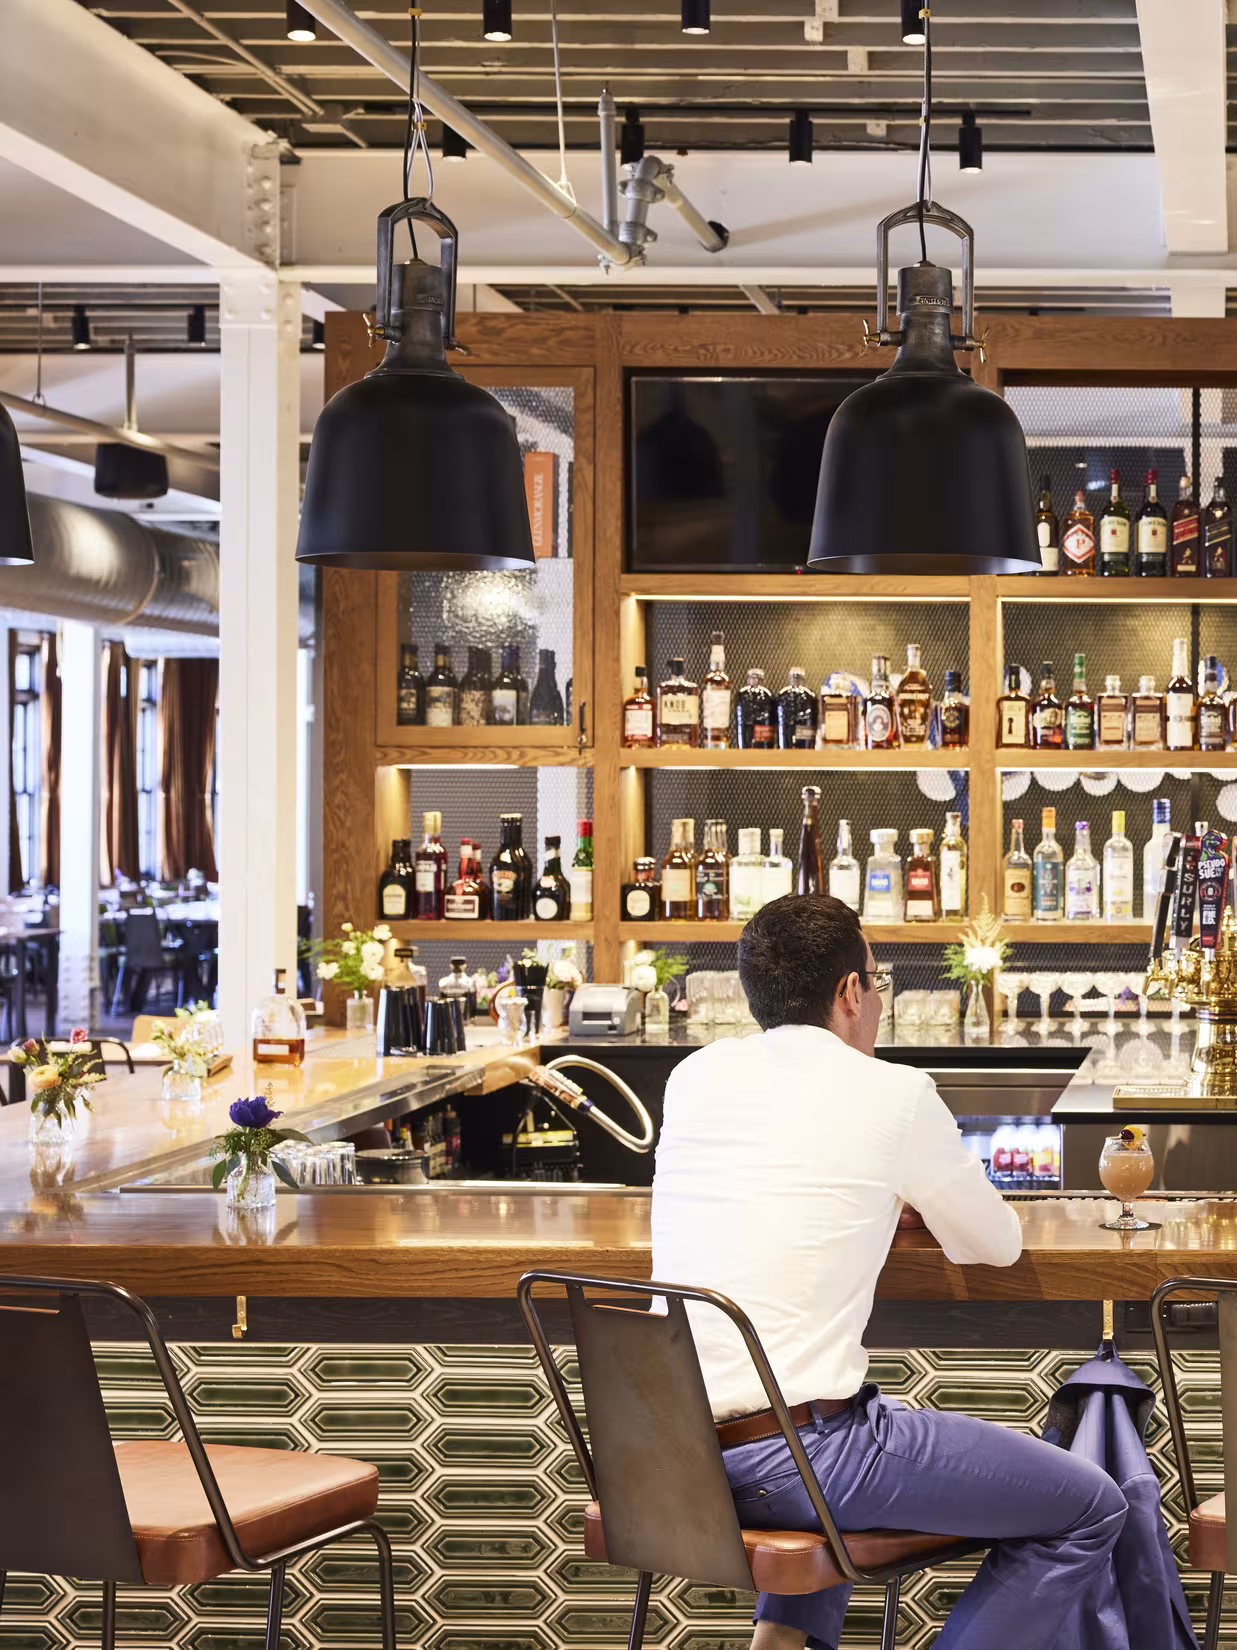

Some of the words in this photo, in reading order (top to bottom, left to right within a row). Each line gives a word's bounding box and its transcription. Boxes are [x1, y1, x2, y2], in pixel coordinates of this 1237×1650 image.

[1075, 539, 1086, 549] P
[663, 700, 686, 710] KNOB
[1198, 858, 1226, 870] PSEUDO
[1199, 868, 1217, 880] SUE
[1180, 873, 1195, 930] SURLY
